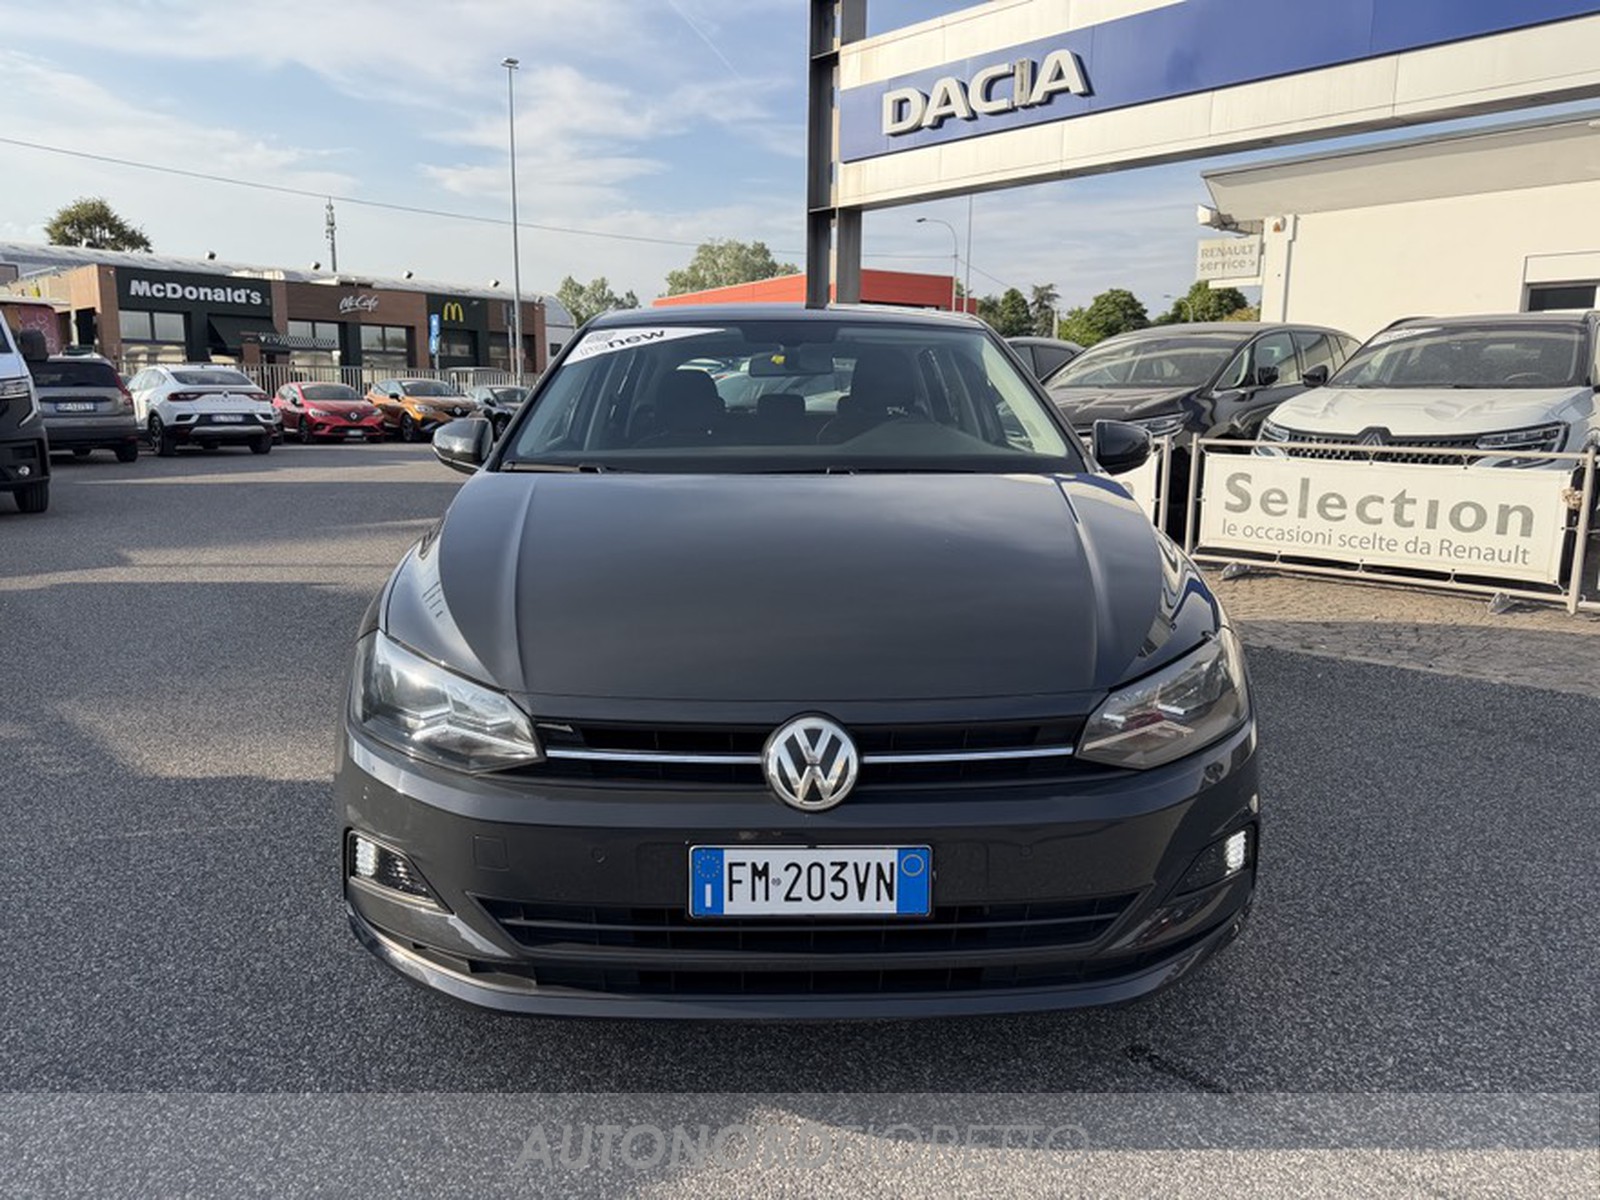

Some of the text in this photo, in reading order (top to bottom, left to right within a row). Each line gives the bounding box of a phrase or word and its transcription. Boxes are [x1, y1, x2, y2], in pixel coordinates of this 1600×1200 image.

[881, 48, 1090, 136] DACIA
[1199, 257, 1247, 272] service
[1200, 243, 1256, 258] RENAULT
[129, 279, 263, 305] McDonald's
[1223, 471, 1535, 538] Selection
[1221, 518, 1532, 566] le occasioni scelte da Renault
